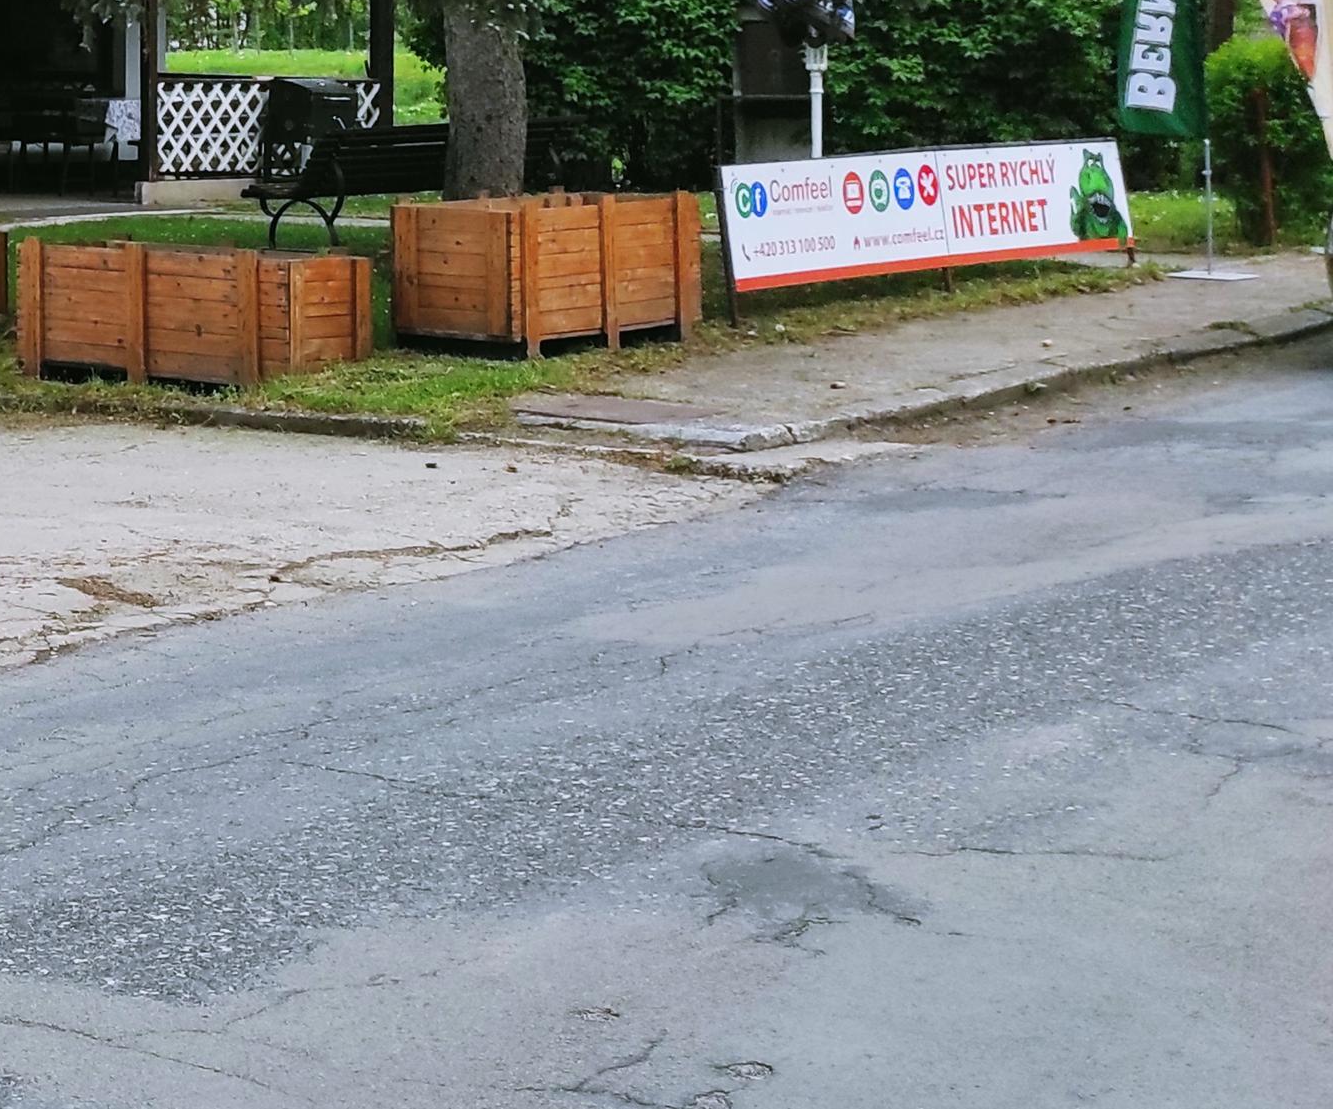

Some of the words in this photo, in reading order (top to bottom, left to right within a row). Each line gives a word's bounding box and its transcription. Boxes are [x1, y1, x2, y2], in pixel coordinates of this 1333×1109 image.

[769, 176, 833, 203] Comfeel
[946, 163, 998, 191] SUPER
[999, 153, 1055, 187] RYCHLÝ
[951, 199, 1049, 239] INTERNET
